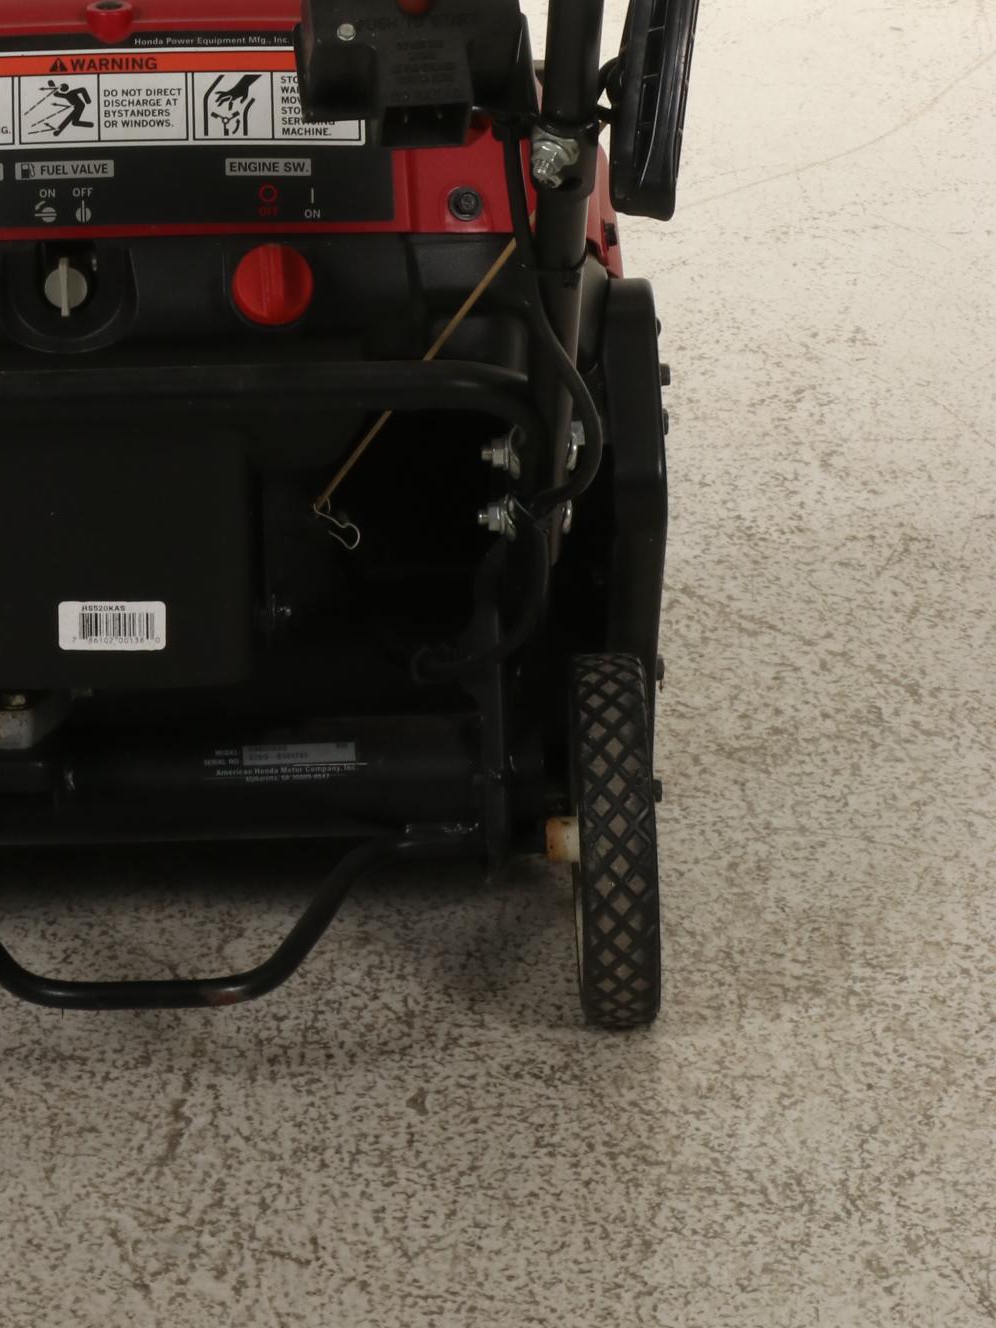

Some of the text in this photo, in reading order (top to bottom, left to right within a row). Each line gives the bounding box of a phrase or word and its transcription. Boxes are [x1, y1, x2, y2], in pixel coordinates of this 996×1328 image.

[134, 36, 290, 46] Honda Power Equipment Mfg., Inc.
[71, 57, 158, 72] WARNING
[103, 88, 181, 97] DO NOT DIRECT
[104, 98, 178, 107] DISCHARGE AT
[104, 109, 170, 117] BYSTANDERS
[104, 119, 174, 127] OR WINDOWS.
[282, 128, 331, 136] MACHINE.
[40, 164, 109, 176] FUEL VALVE
[229, 161, 309, 173] ENGINE SW.
[39, 188, 93, 198] ON OFF
[259, 206, 321, 218] OFF ON
